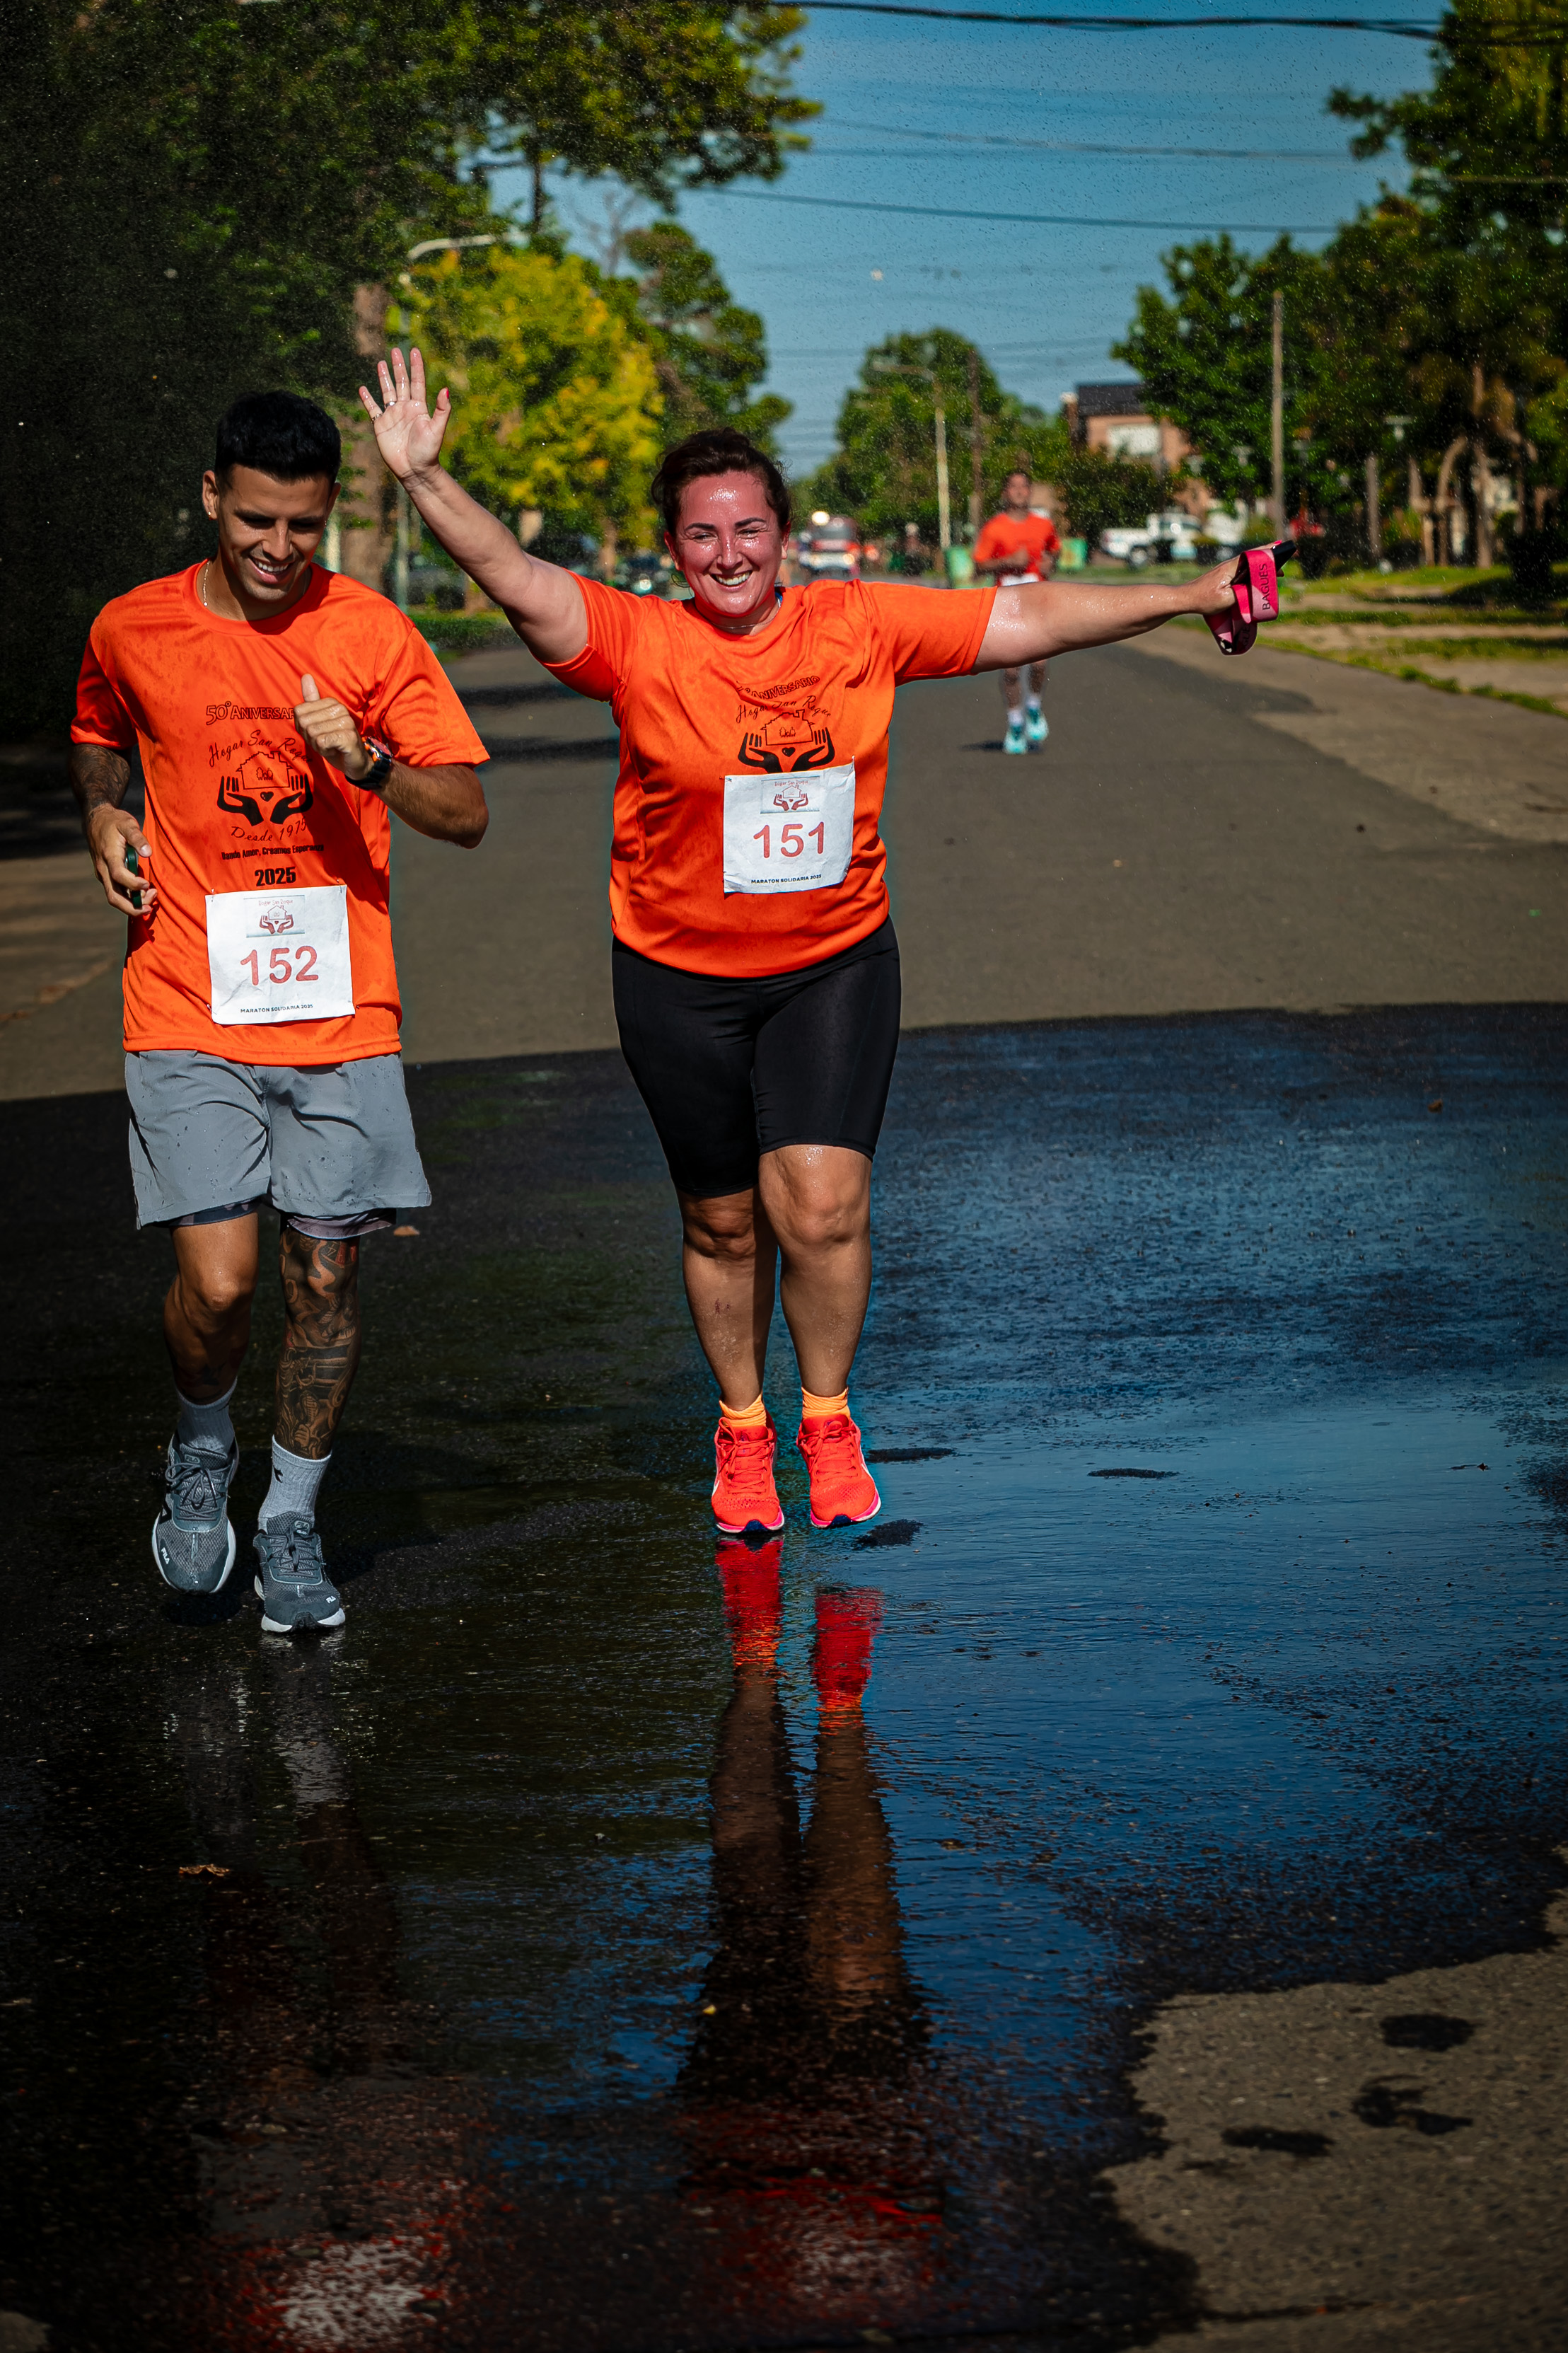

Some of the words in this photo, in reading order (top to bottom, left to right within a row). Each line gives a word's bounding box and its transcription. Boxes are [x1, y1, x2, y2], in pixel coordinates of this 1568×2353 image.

[1259, 563, 1271, 611] BAGUES
[751, 676, 820, 700] ANIVERSARIO
[230, 705, 294, 720] ANIVERSAR
[802, 695, 832, 717] Roque
[209, 741, 243, 768] Hogar
[248, 729, 273, 747] San
[231, 826, 273, 842] Desde
[279, 816, 307, 840] 1975
[753, 821, 825, 859] 151
[221, 850, 241, 860] Dando
[242, 848, 262, 858] Amor,
[262, 846, 291, 855] Creamos
[292, 844, 325, 854] Esperanza
[254, 866, 296, 886] 2025
[240, 945, 319, 985] 152
[161, 1546, 170, 1565] FILA
[325, 1595, 337, 1604] FILA
